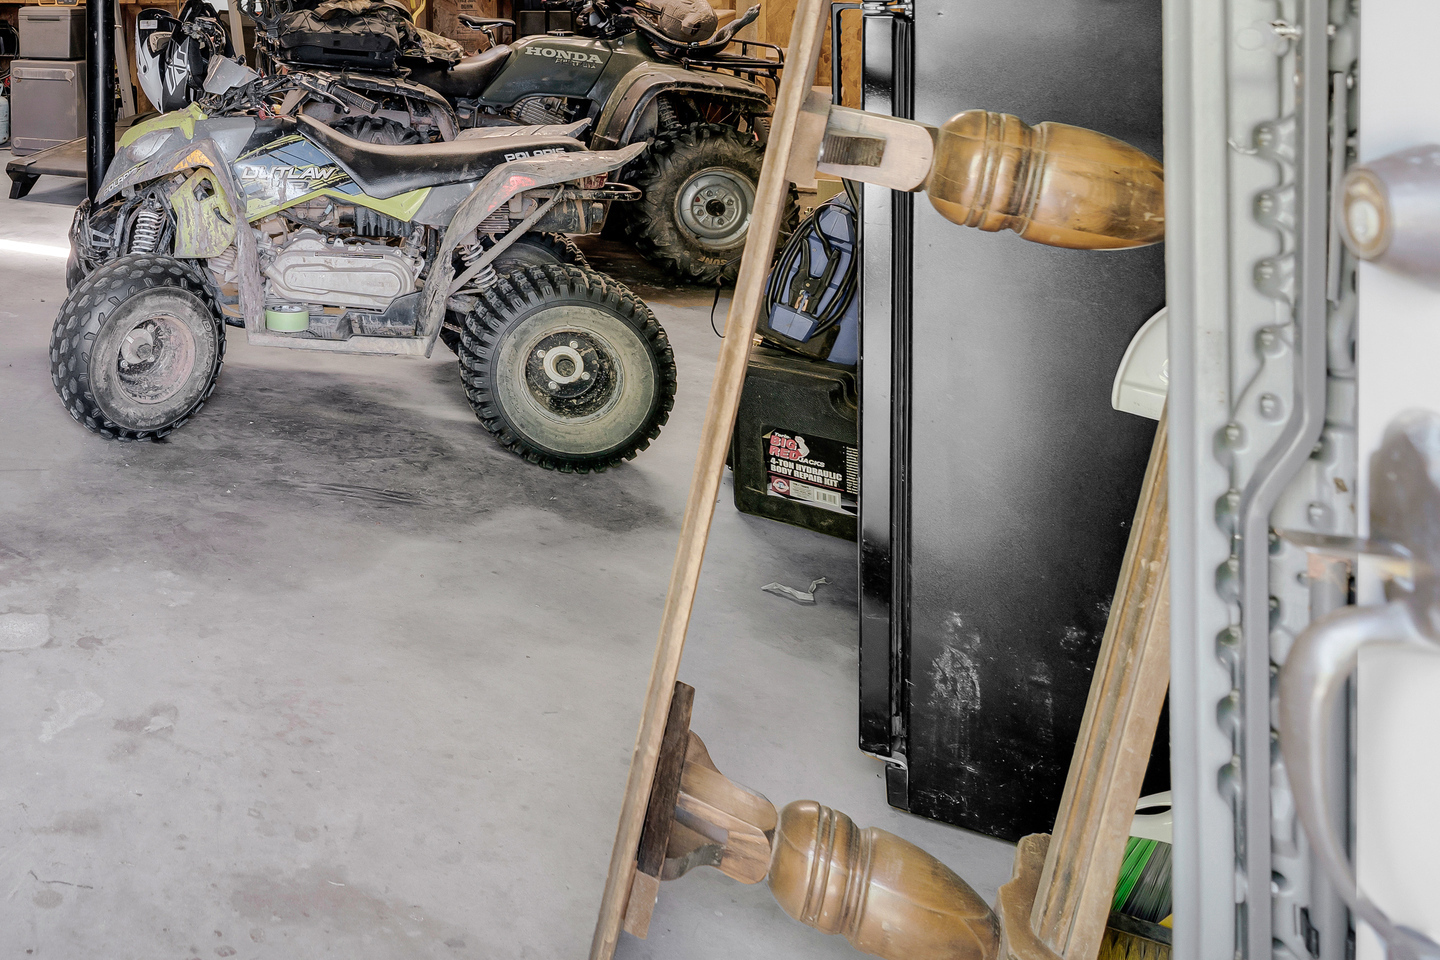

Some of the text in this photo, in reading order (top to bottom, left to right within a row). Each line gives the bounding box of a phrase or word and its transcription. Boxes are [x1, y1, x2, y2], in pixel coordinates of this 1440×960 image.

[524, 46, 604, 64] HONDA
[241, 165, 339, 180] OUTLAW
[770, 434, 798, 450] BIG
[769, 445, 800, 460] RED
[770, 457, 842, 481] 4-TON HYDRAULIC
[798, 456, 826, 468] JACKS
[770, 464, 839, 488] BODY REPAIR KIT
